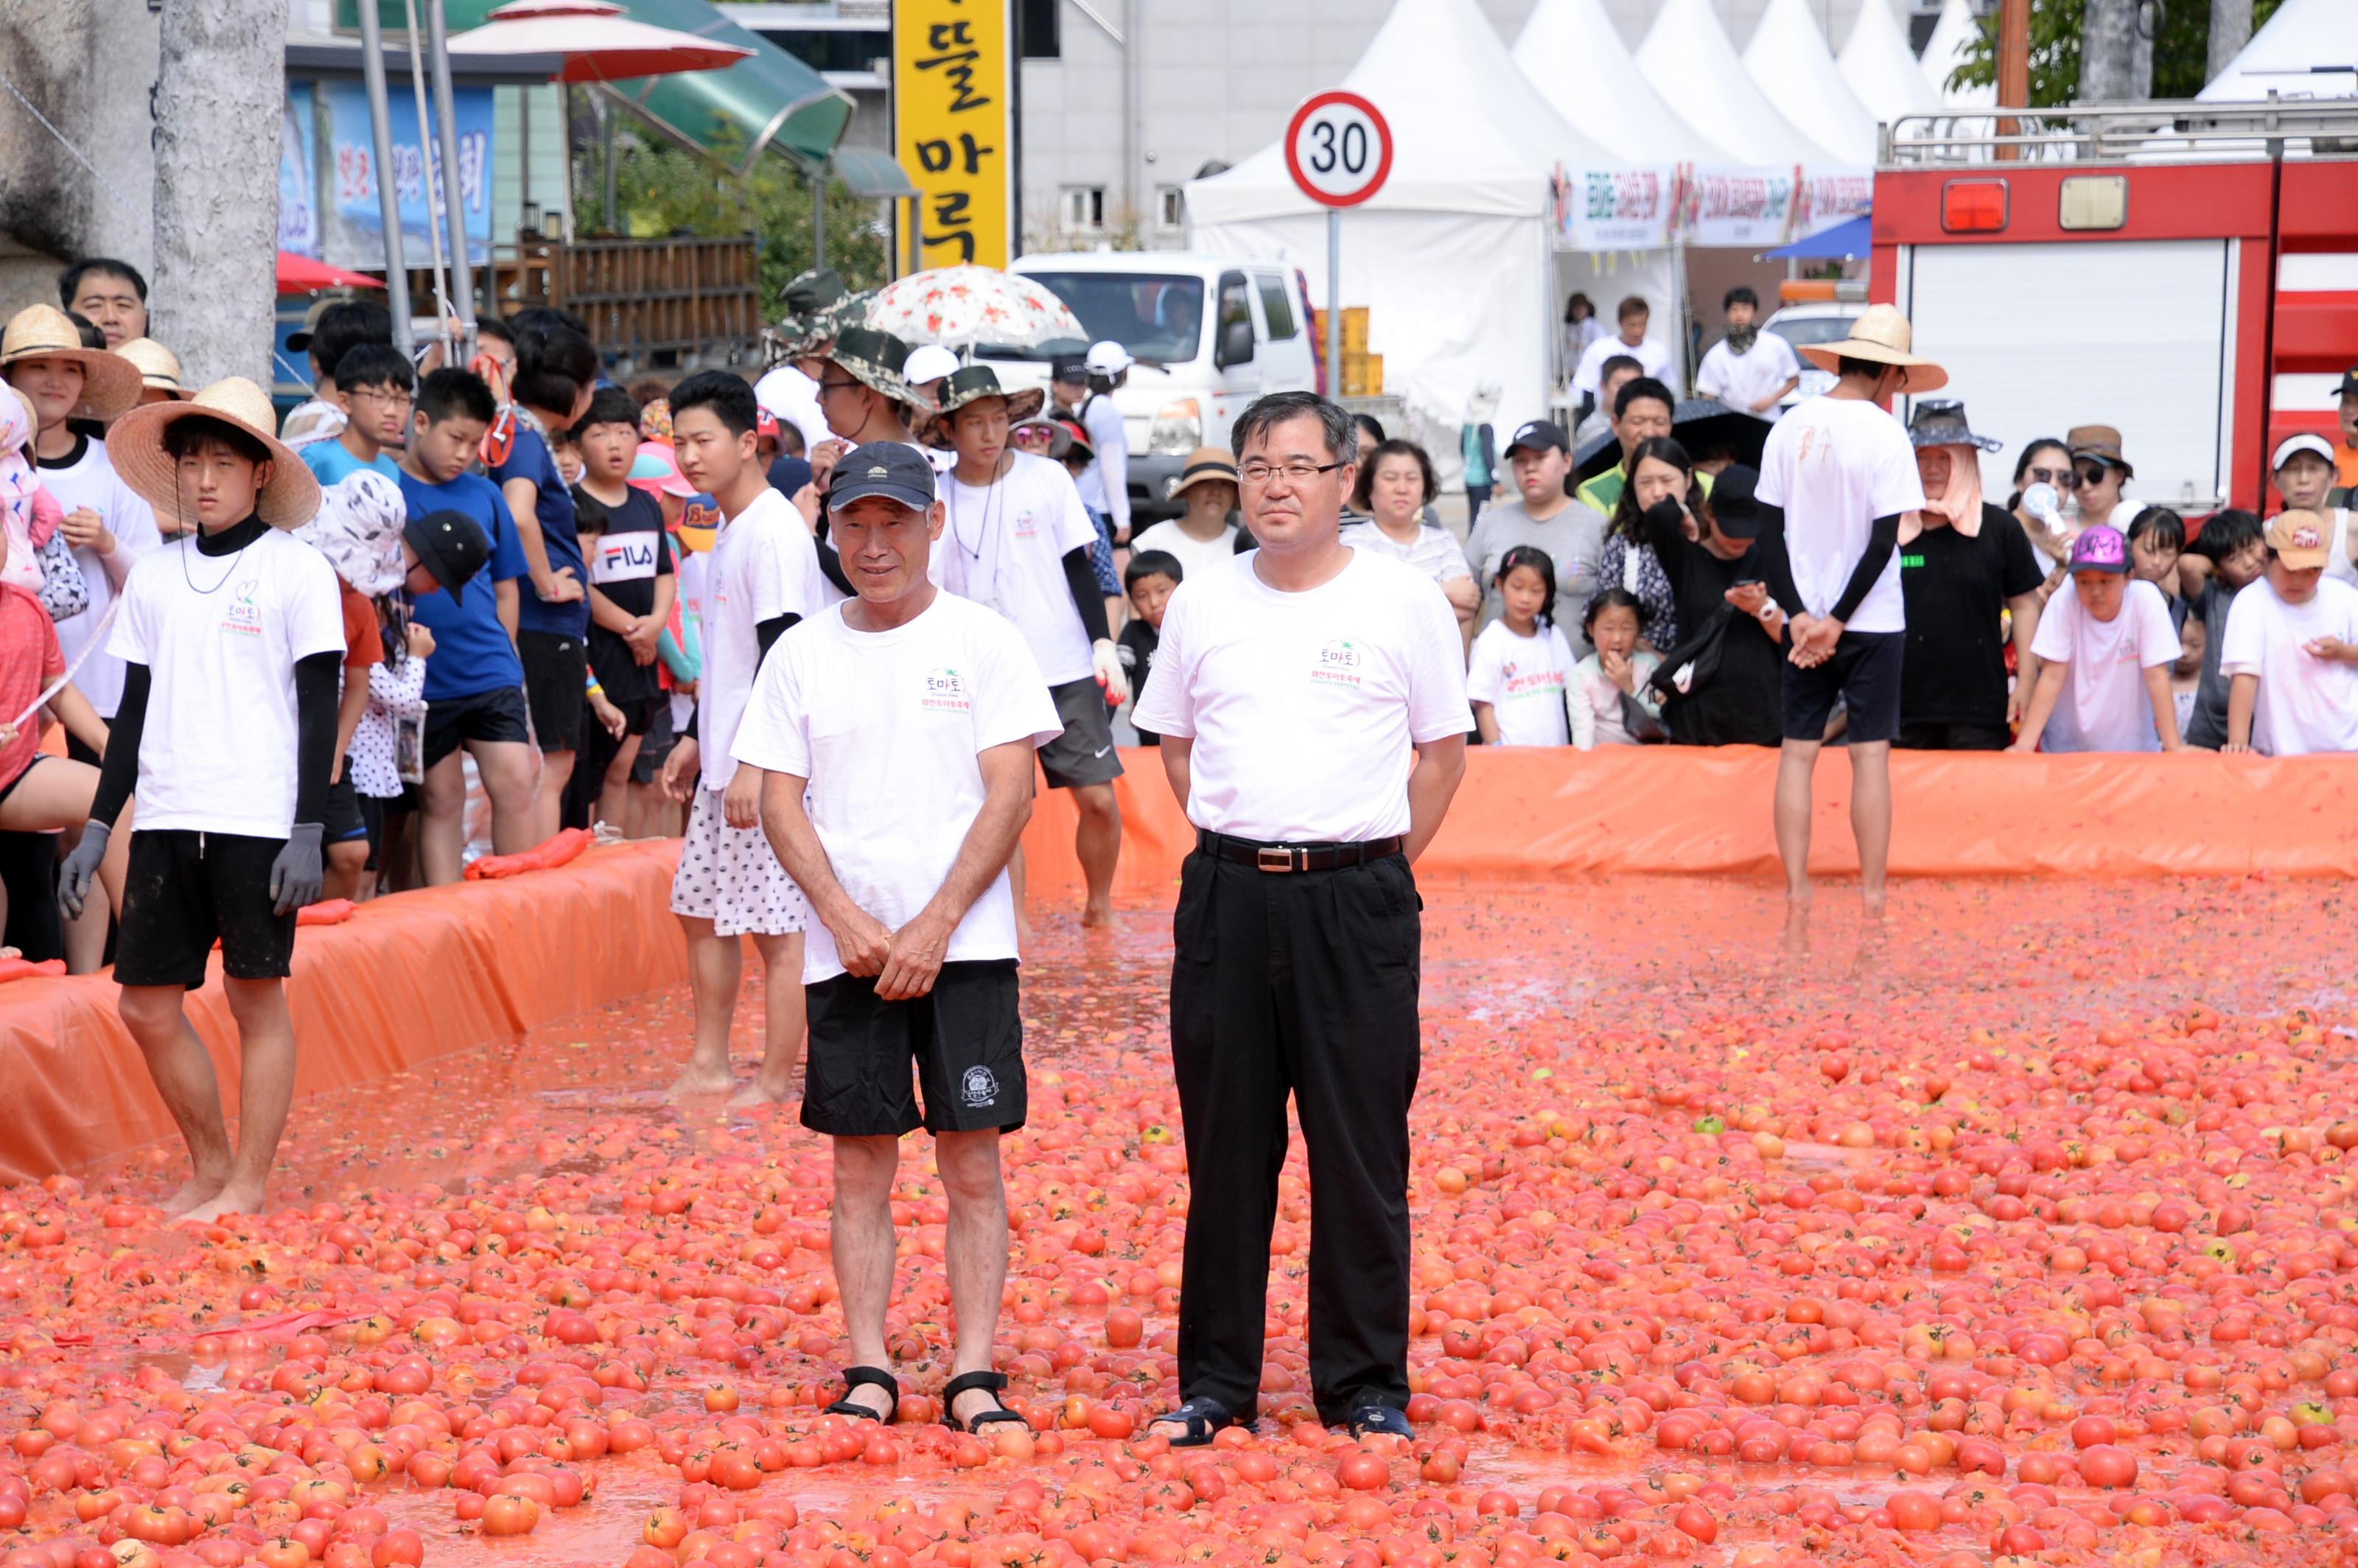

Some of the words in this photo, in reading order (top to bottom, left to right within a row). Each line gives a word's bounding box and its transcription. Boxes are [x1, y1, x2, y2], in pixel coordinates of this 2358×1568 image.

[914, 0, 994, 263] 뜰마루
[1310, 121, 1368, 175] 30
[605, 545, 652, 570] FILA
[1319, 648, 1354, 666] 토마토
[926, 677, 962, 692] 토마토
